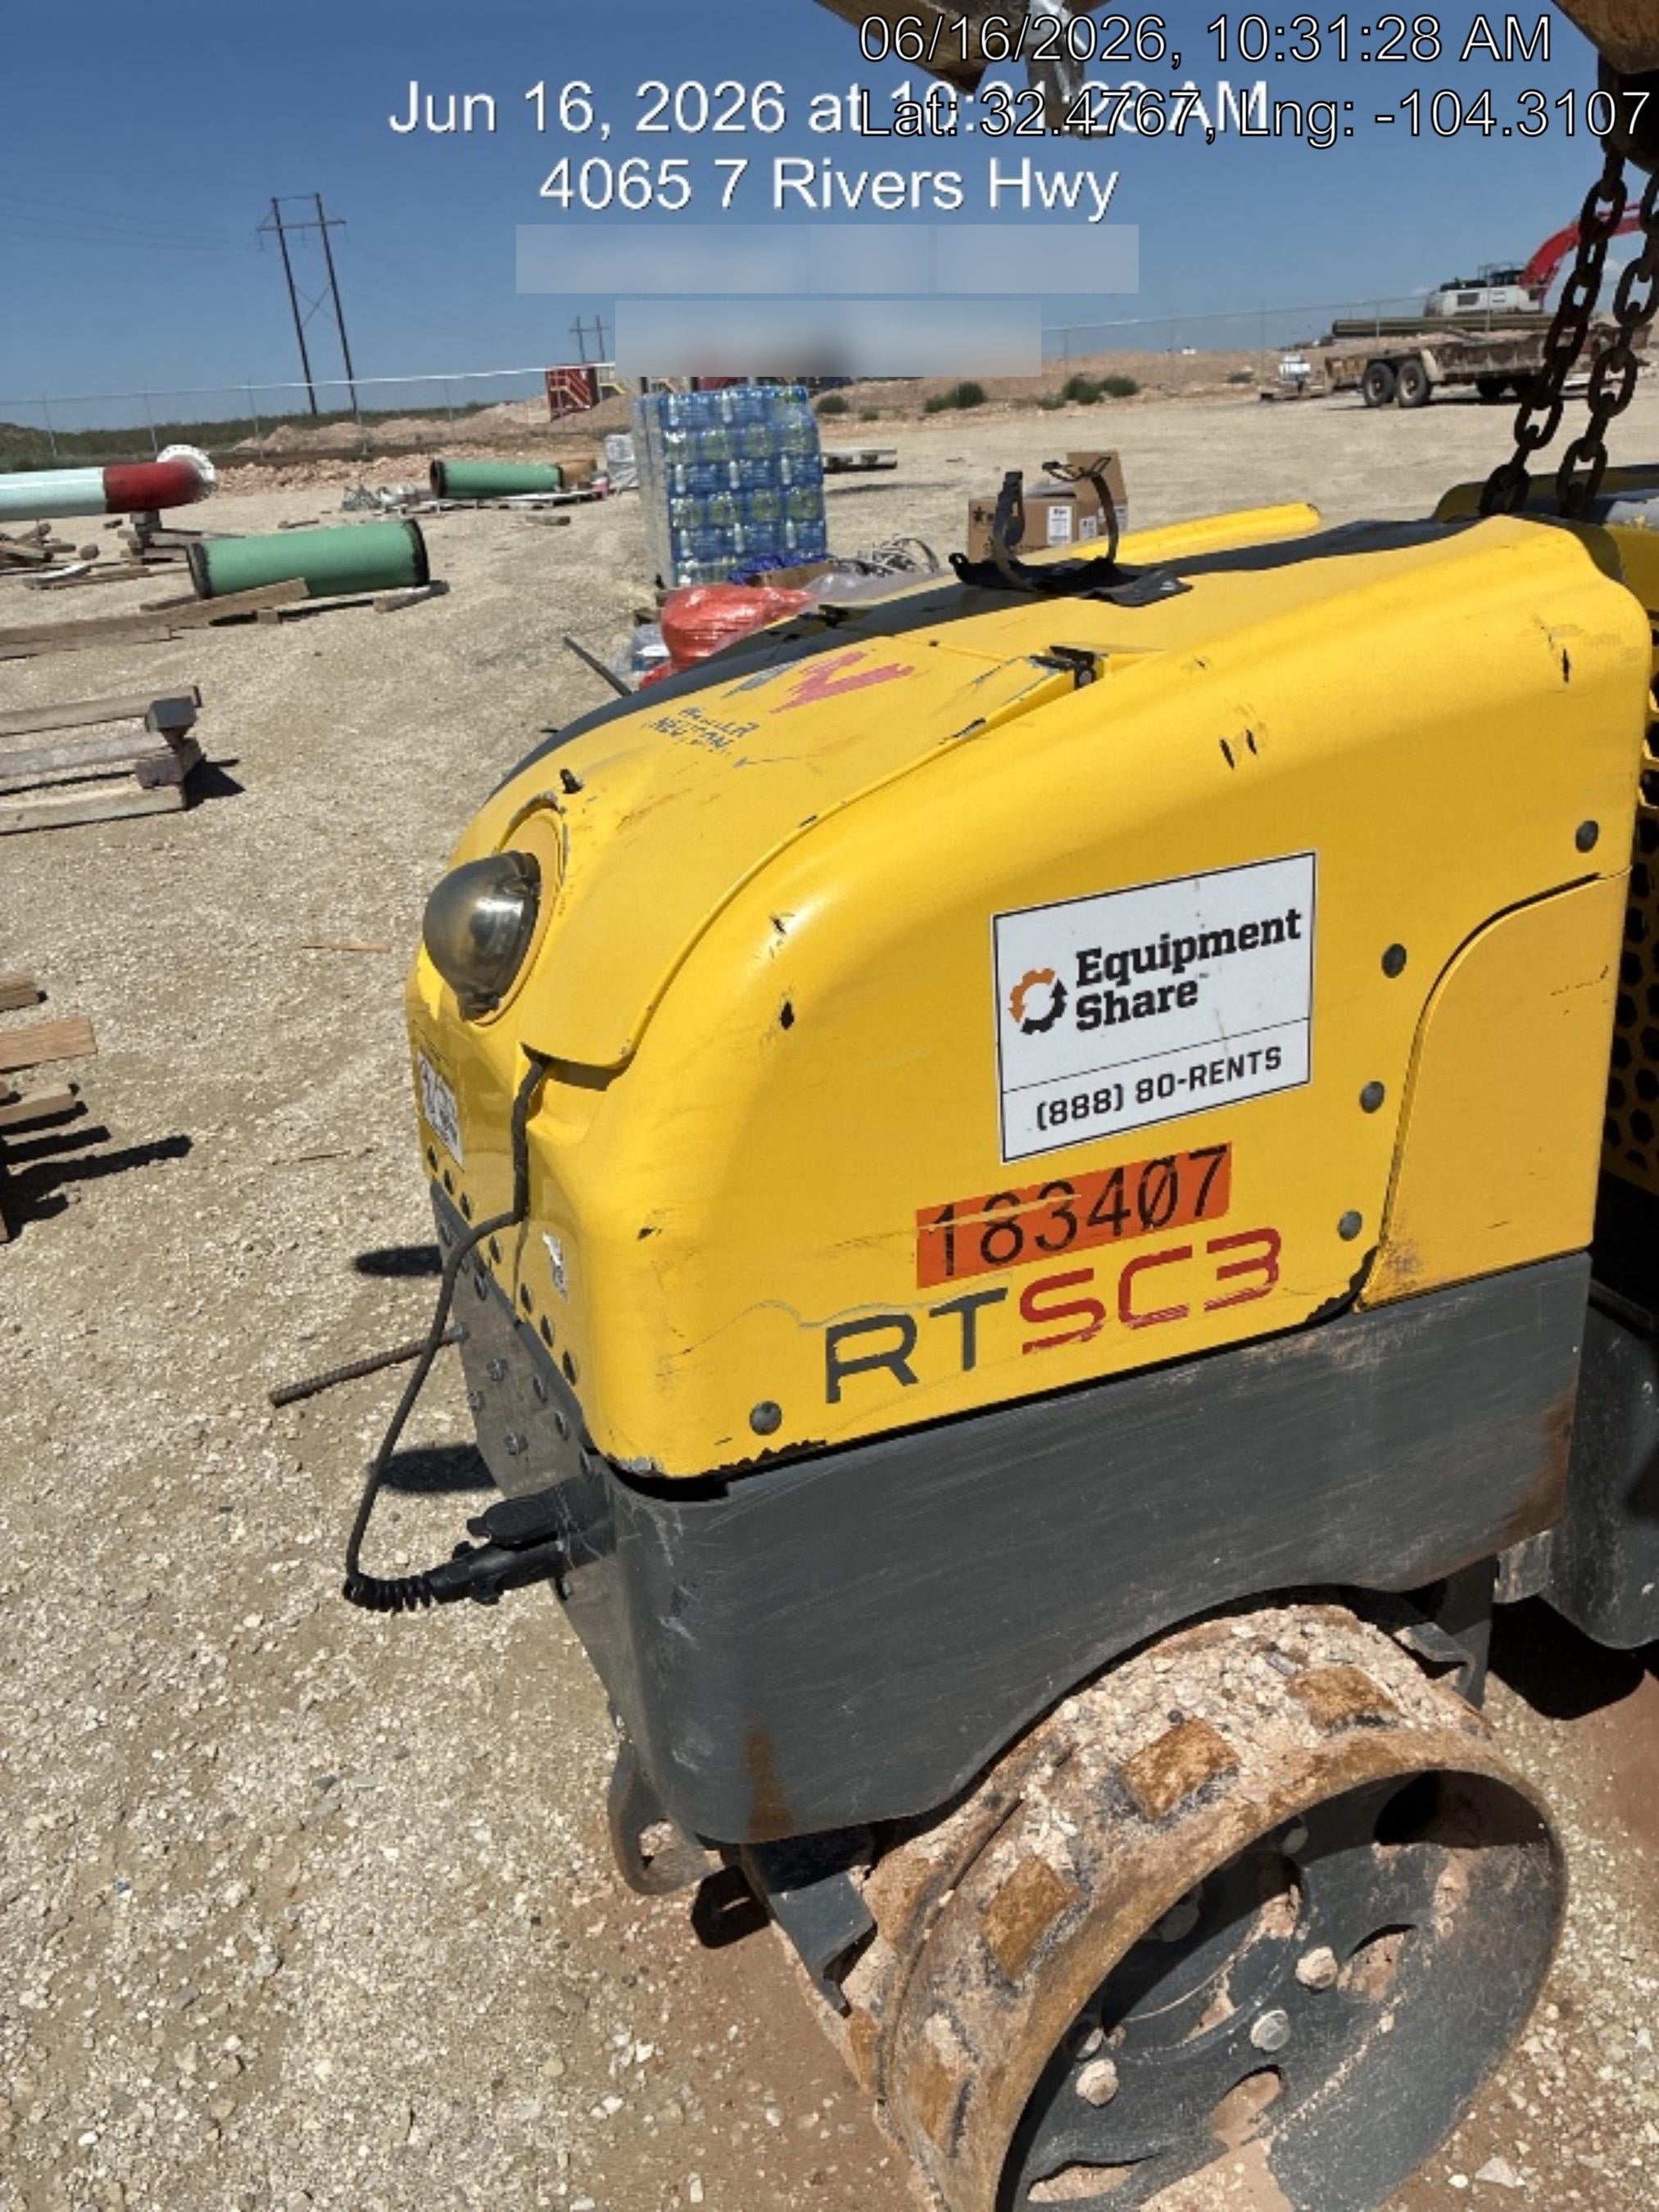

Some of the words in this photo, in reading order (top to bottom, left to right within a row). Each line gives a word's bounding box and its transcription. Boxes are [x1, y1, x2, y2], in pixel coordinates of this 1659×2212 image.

[1075, 908, 1303, 989] Equipment
[1075, 979, 1199, 1031] Share
[1036, 1082, 1125, 1131] (888)
[1135, 1045, 1283, 1105] 80-RENTS
[922, 1145, 1229, 1277] 183407
[825, 1226, 1282, 1404] RTSC3
